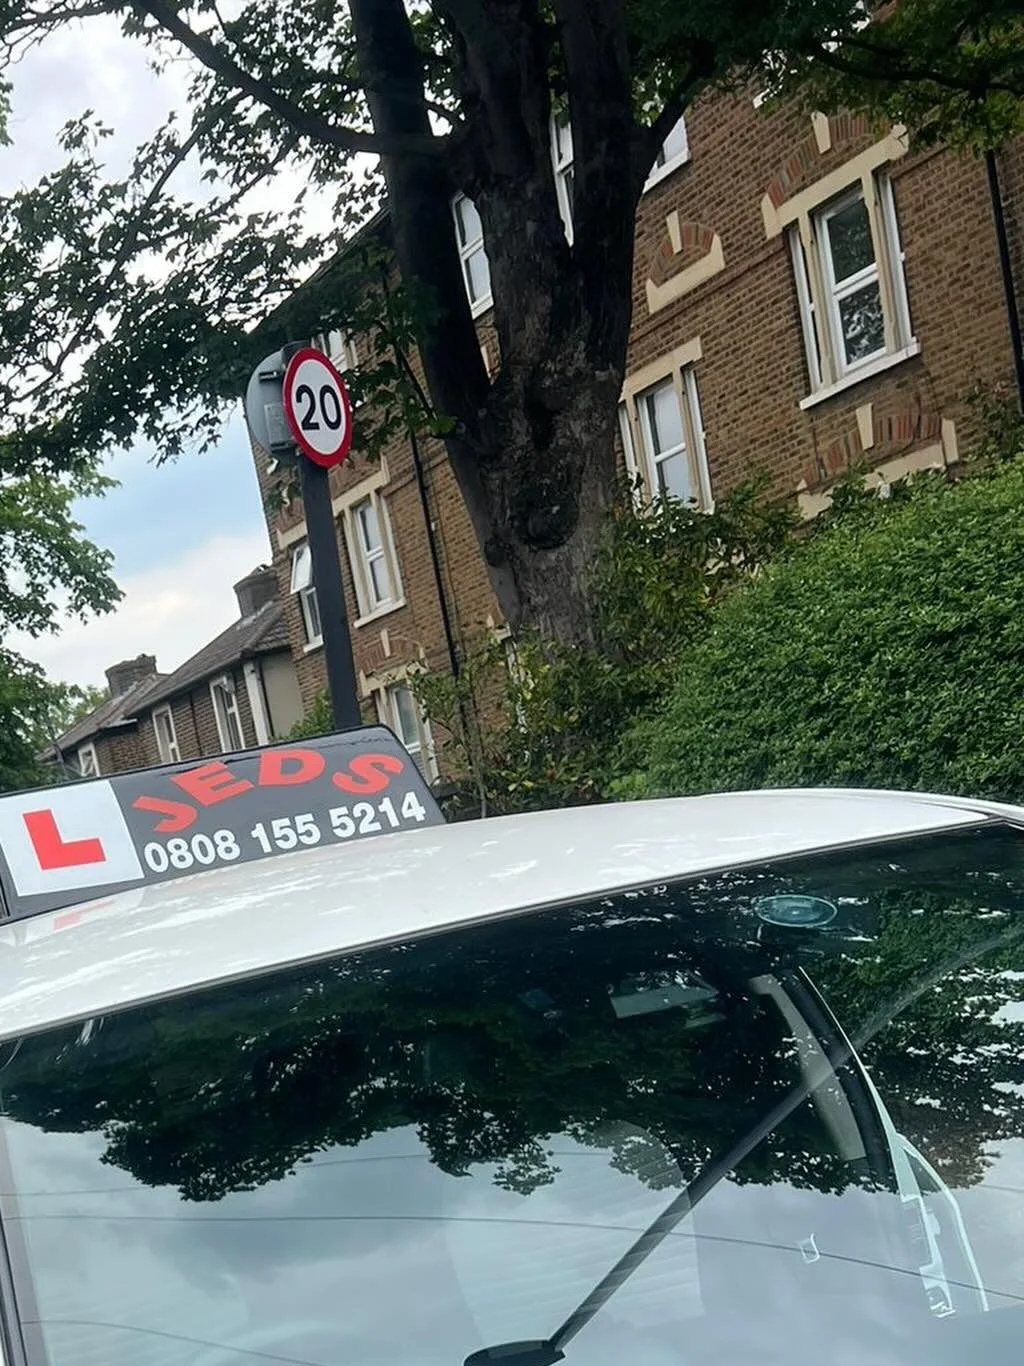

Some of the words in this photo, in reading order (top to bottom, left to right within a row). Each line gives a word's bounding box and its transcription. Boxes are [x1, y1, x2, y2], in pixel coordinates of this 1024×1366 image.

[295, 384, 342, 431] 20
[132, 749, 404, 833] JEDS
[22, 808, 107, 870] L
[144, 829, 241, 873] 0808
[251, 814, 321, 853] 155
[329, 791, 425, 838] 5214
